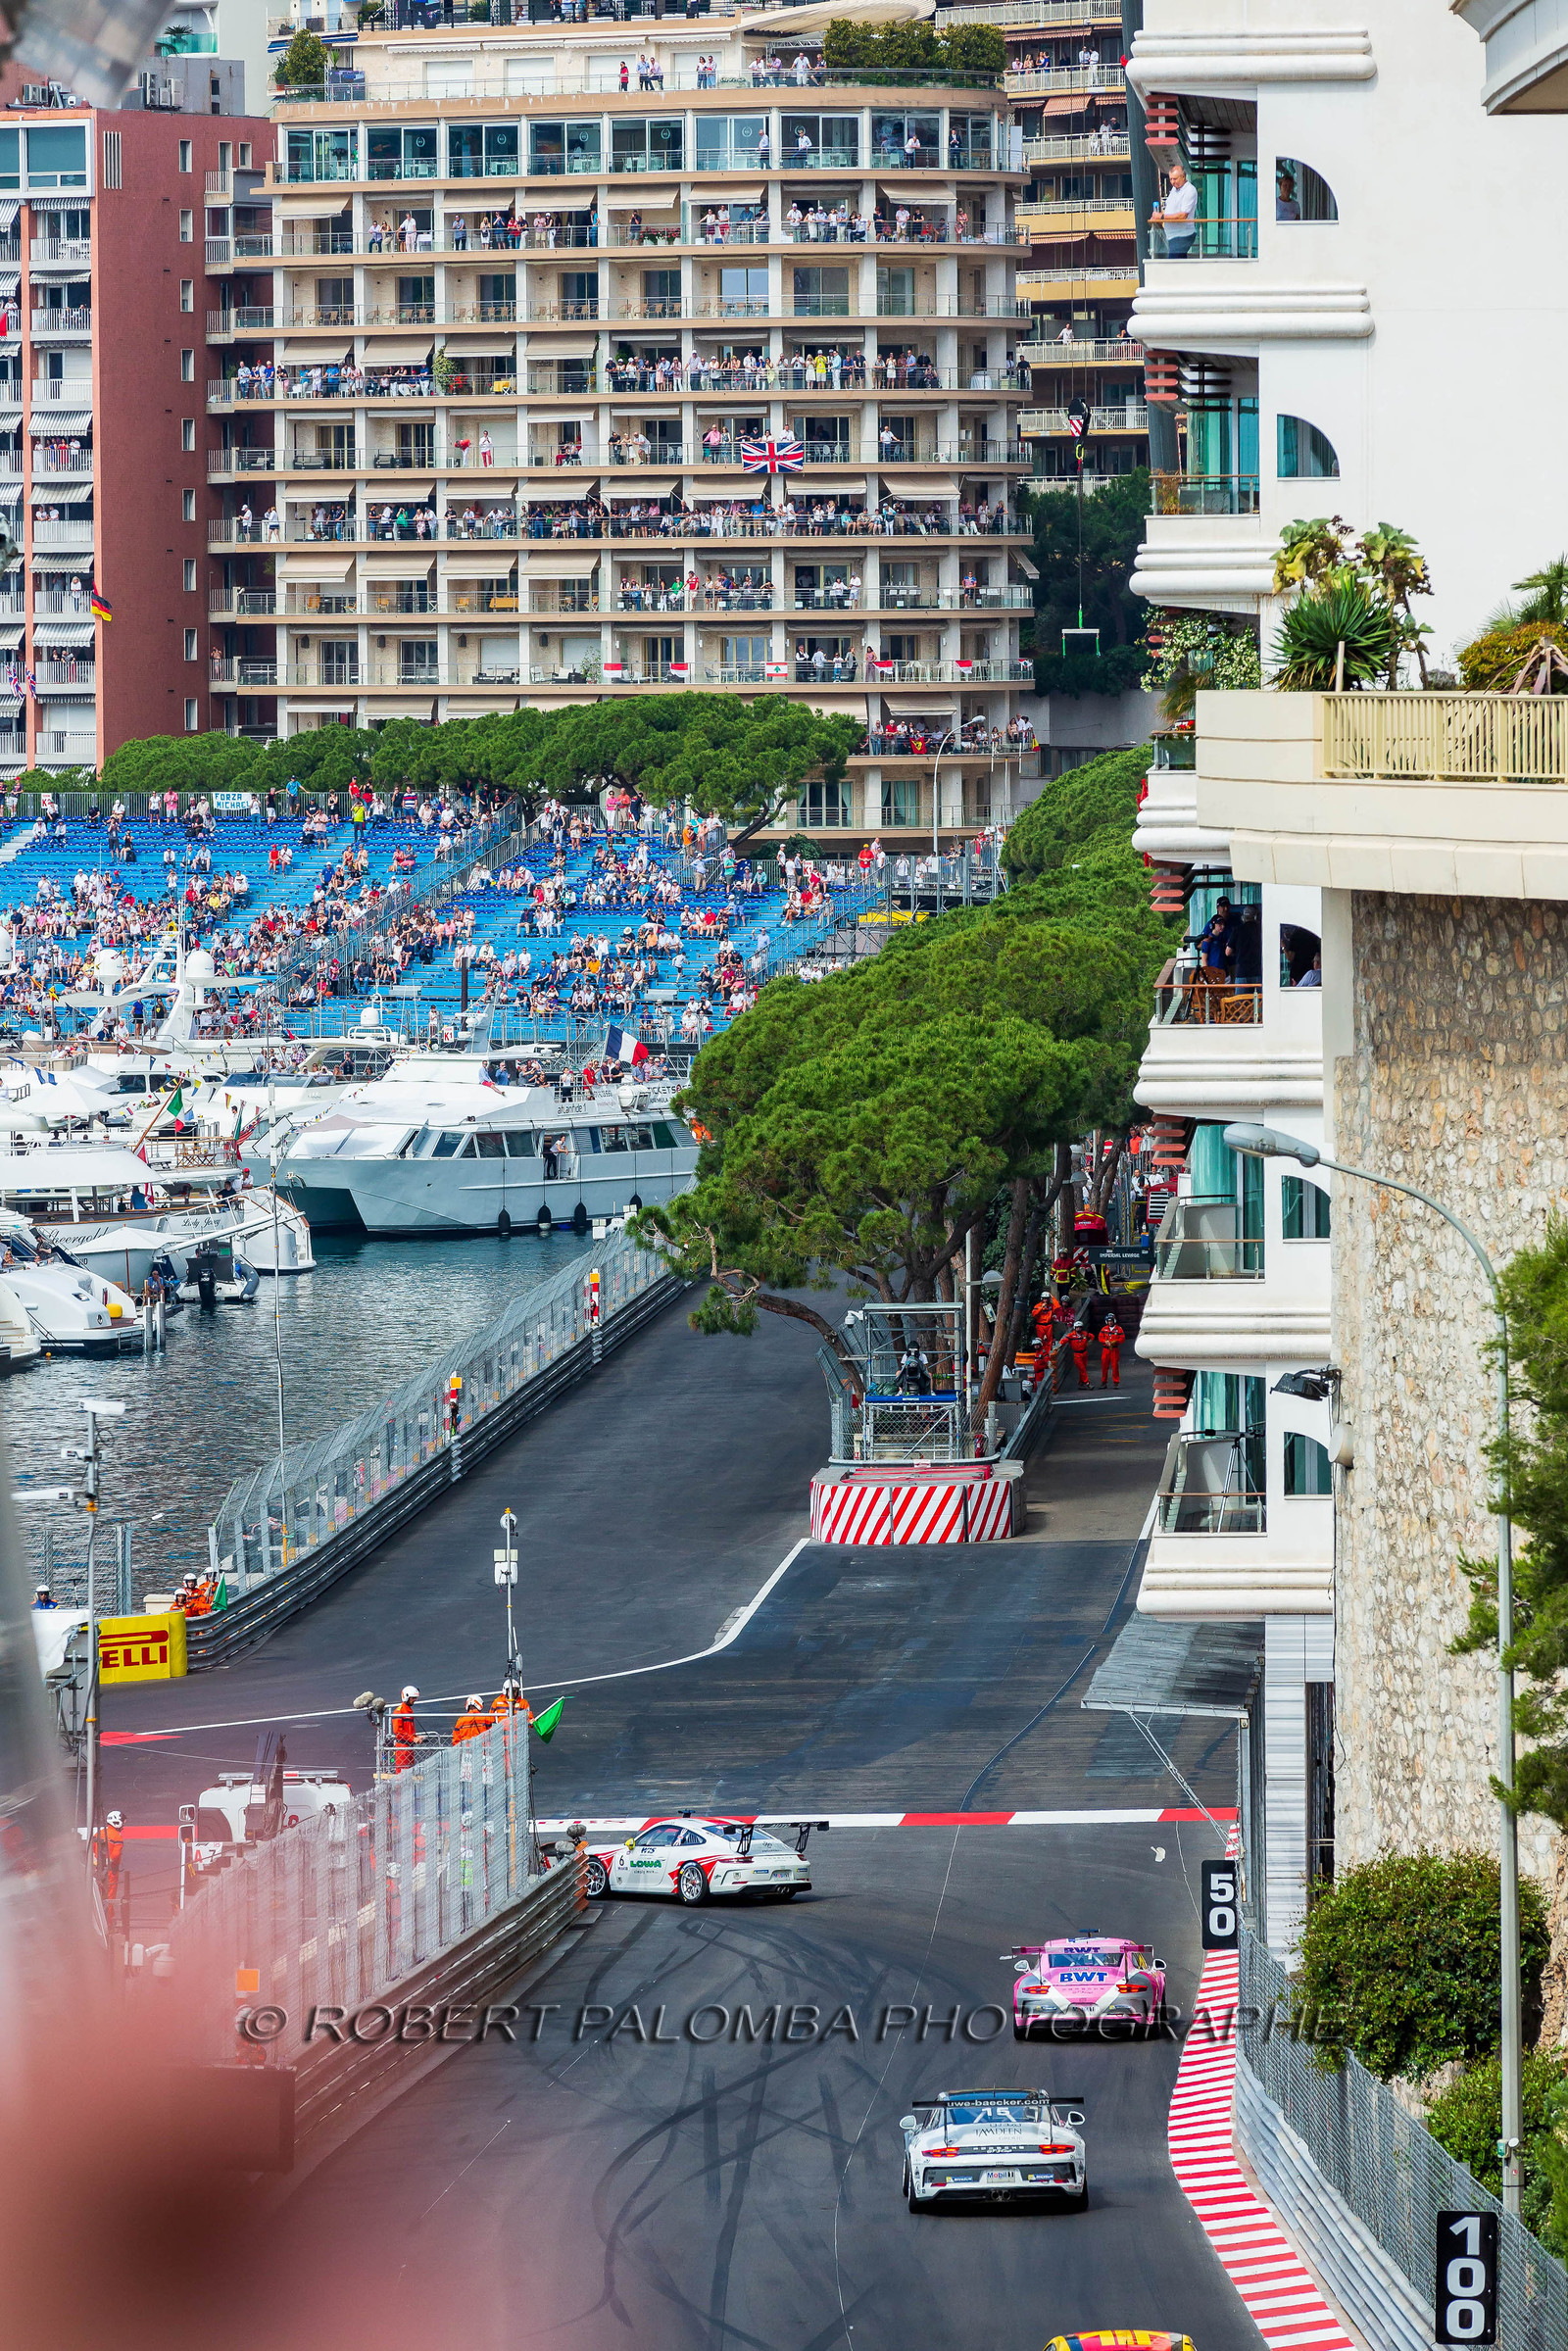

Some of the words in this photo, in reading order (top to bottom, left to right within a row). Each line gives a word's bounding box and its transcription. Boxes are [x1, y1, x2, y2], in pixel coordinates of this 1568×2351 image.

[444, 1032, 453, 1041] K1
[618, 1855, 625, 1867] 6
[1208, 1873, 1236, 1937] 50
[1059, 1972, 1108, 1983] BWT
[947, 2098, 1051, 2107] uwe-baecker.com
[981, 2107, 1010, 2117] 15
[1446, 2216, 1487, 2339] 100
